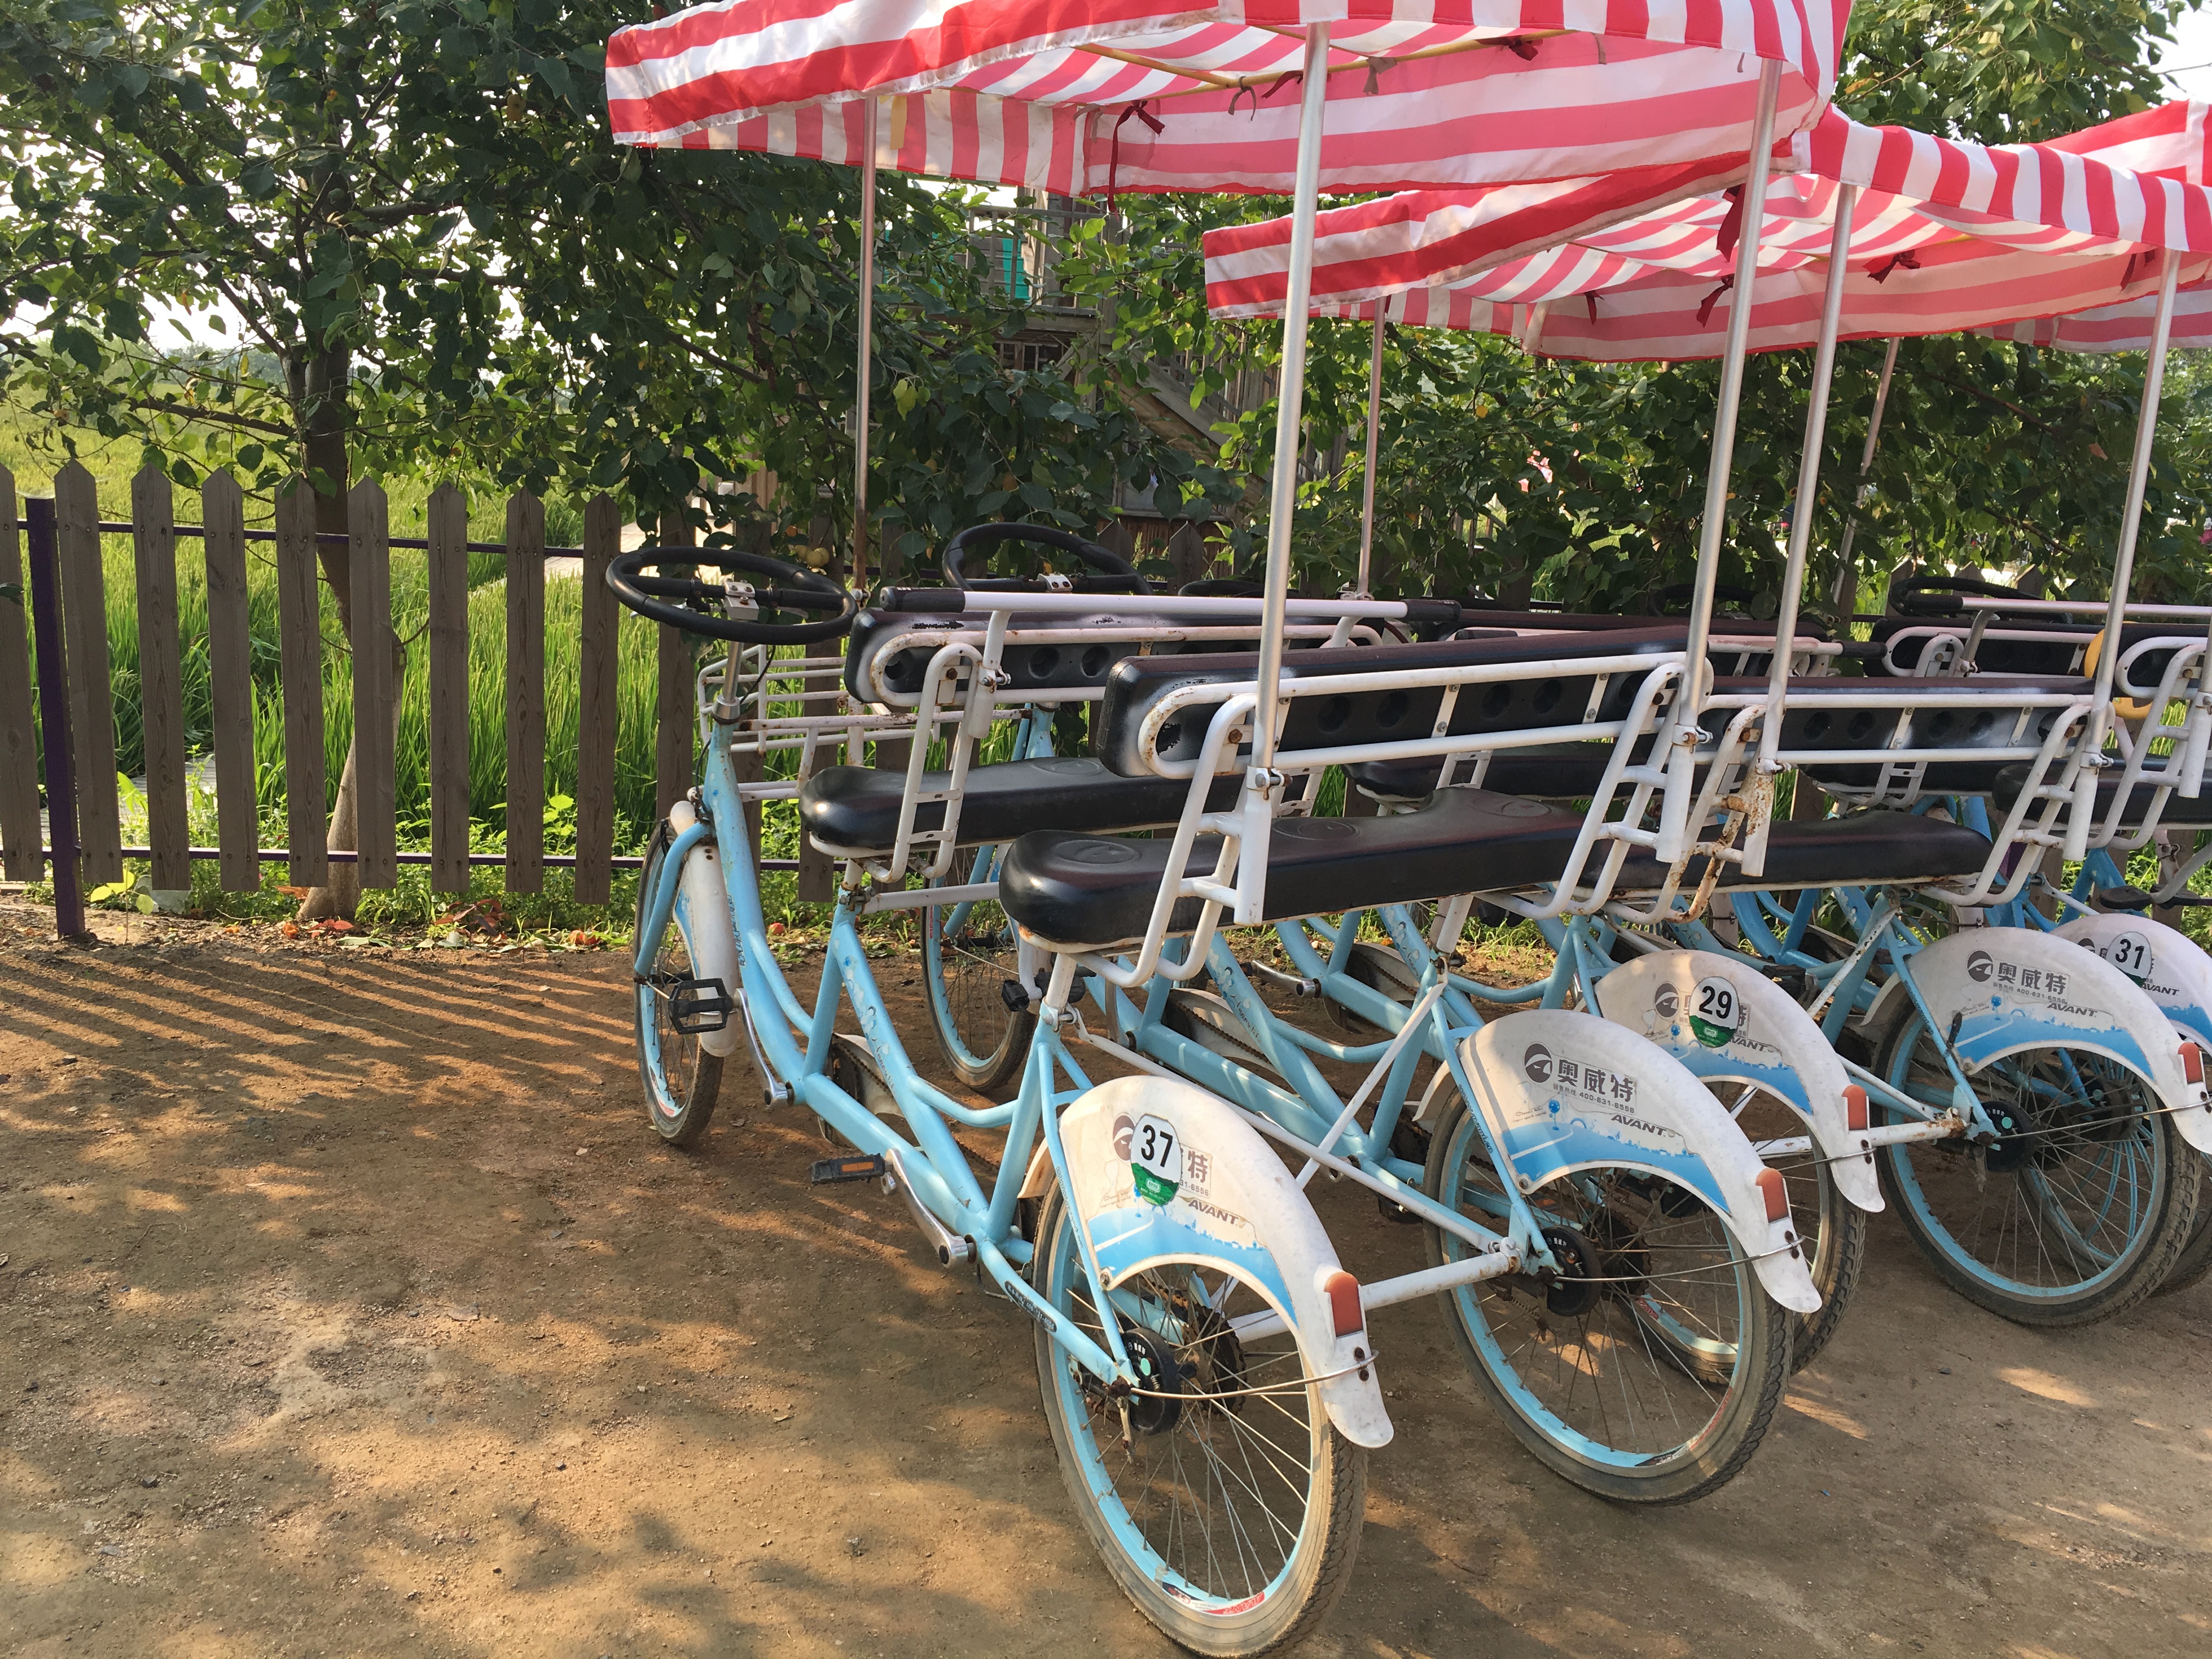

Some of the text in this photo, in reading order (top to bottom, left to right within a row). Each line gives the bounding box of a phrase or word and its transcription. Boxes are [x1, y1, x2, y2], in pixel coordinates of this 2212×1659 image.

[2115, 938, 2145, 969] 31
[1997, 962, 2067, 995] 奥威特
[1229, 994, 1251, 1028] Happy
[1699, 985, 1732, 1019] 29
[1729, 1036, 1768, 1052] VANT
[1558, 1059, 1633, 1103] 奥威特
[1141, 1124, 1173, 1167] 37
[1181, 1148, 1208, 1183] 特
